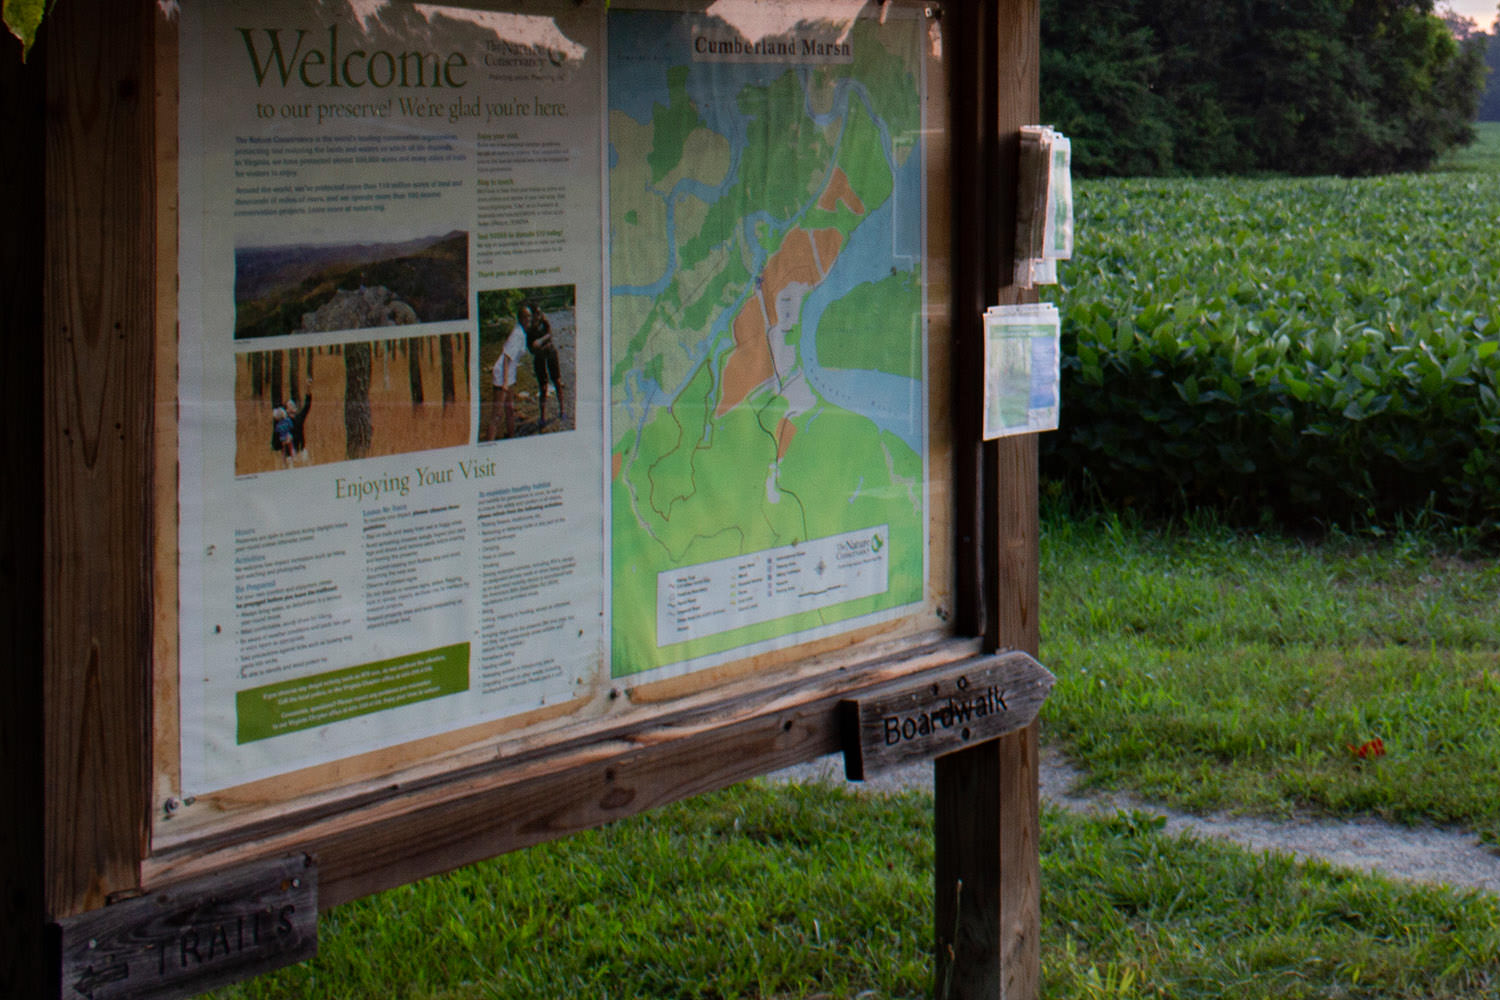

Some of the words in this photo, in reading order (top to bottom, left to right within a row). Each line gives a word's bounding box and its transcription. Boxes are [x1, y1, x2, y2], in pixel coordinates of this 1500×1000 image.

[235, 24, 468, 89] Welcome
[694, 36, 796, 56] Cumberland
[256, 102, 275, 118] to
[281, 104, 313, 118] our
[318, 100, 392, 123] preserve!
[400, 98, 442, 118] We're
[449, 97, 480, 122] glad
[486, 97, 530, 122] you're
[534, 96, 569, 118] here.
[335, 472, 410, 501] Enjoying
[416, 466, 453, 488] Your
[459, 458, 497, 479] Visit
[884, 684, 1008, 747] Boardwalk
[153, 904, 296, 977] TRAILS
